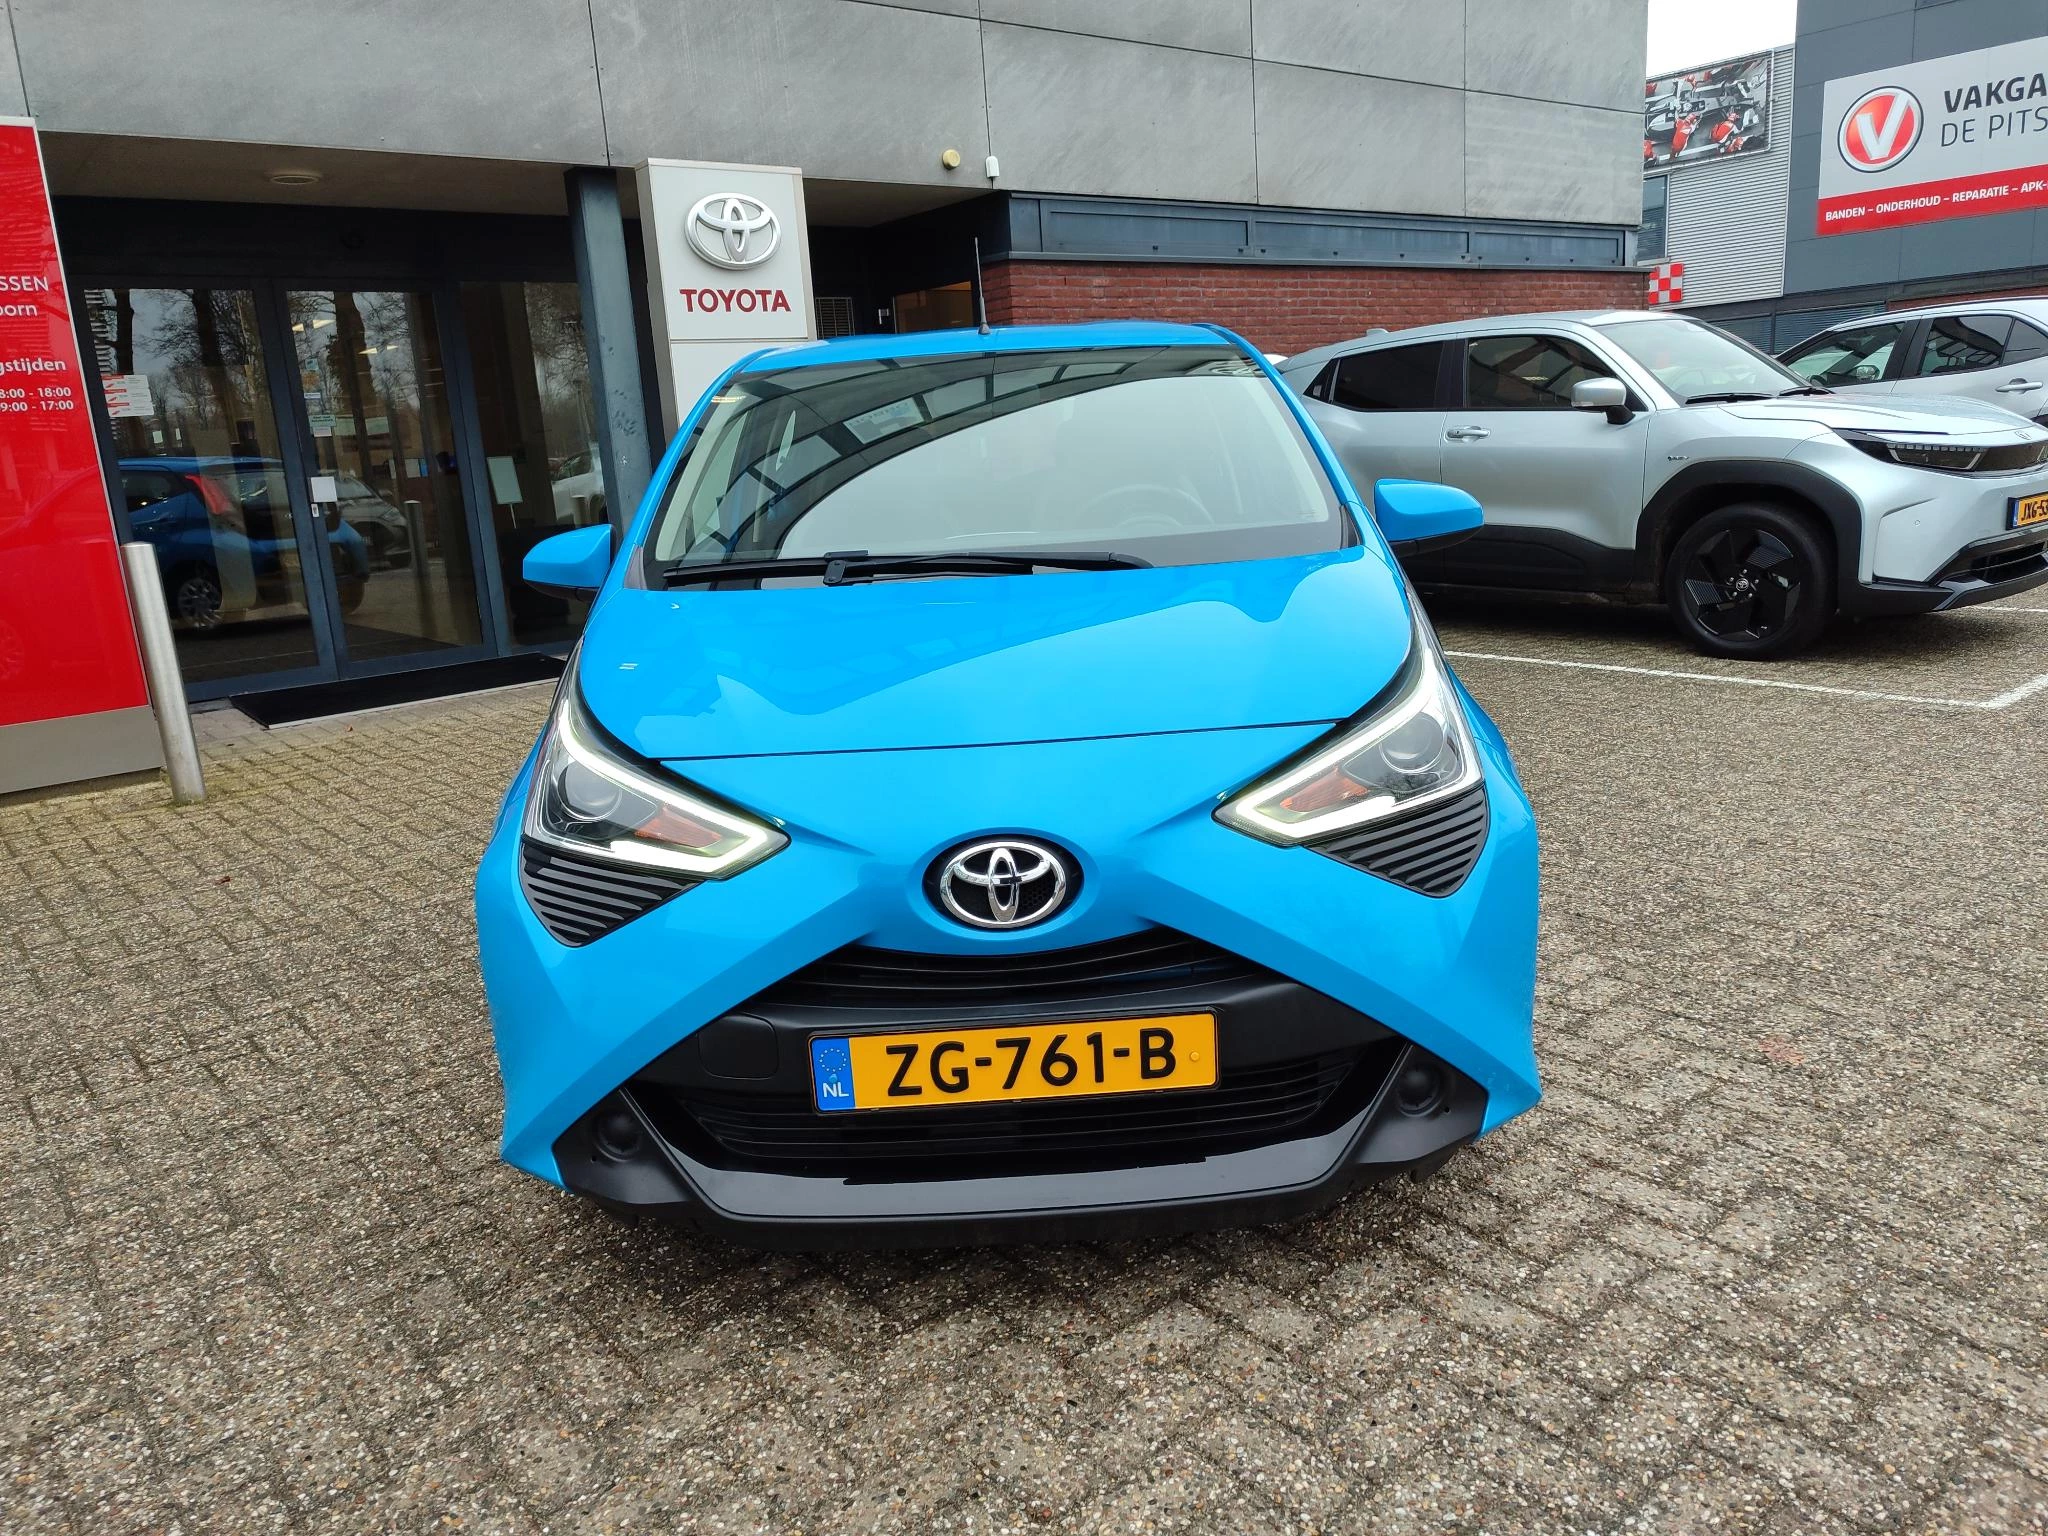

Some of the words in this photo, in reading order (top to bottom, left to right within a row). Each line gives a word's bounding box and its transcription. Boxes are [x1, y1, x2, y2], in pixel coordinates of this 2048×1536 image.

[1943, 72, 2048, 114] VAKGA
[1941, 118, 1976, 147] DE
[1988, 106, 2048, 139] PITS
[1825, 206, 1865, 221] BANDEN
[1876, 195, 1941, 214] ONDERHOUD
[1952, 185, 2009, 202] REPARATIE
[2020, 179, 2048, 194] APK-
[0, 275, 49, 291] SSEN
[0, 303, 38, 316] orn
[679, 288, 791, 313] TOYOTA
[38, 387, 72, 398] 18:00
[40, 400, 74, 411] 17:00
[886, 1027, 1177, 1097] ZG-761-B
[822, 1081, 849, 1098] NL
